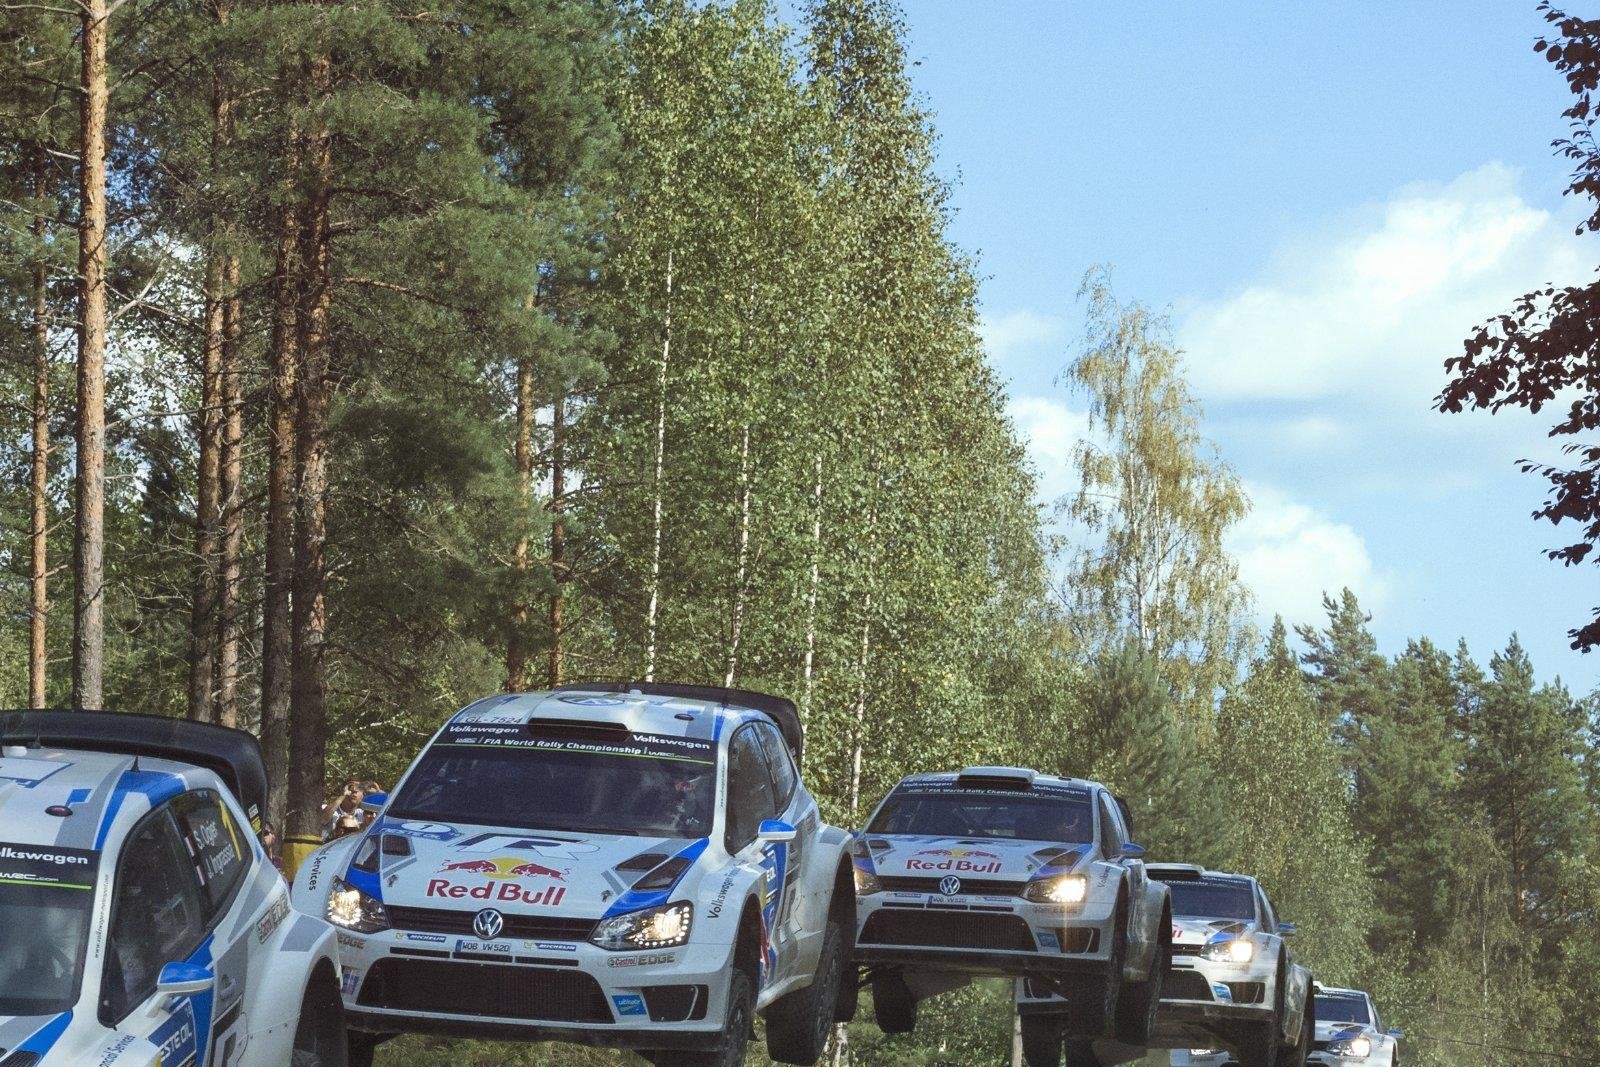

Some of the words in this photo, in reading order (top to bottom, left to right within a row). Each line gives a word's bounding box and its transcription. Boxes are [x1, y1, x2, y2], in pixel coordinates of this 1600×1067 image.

[449, 725, 519, 734] Volkswagen
[504, 739, 535, 747] World
[537, 740, 564, 749] Rally
[566, 742, 642, 755] Championship
[632, 735, 710, 750] Volkswagen
[308, 853, 327, 892] Services
[906, 859, 952, 871] Red
[955, 861, 1002, 873] Bull
[426, 879, 496, 900] Red
[497, 882, 566, 906] Bull
